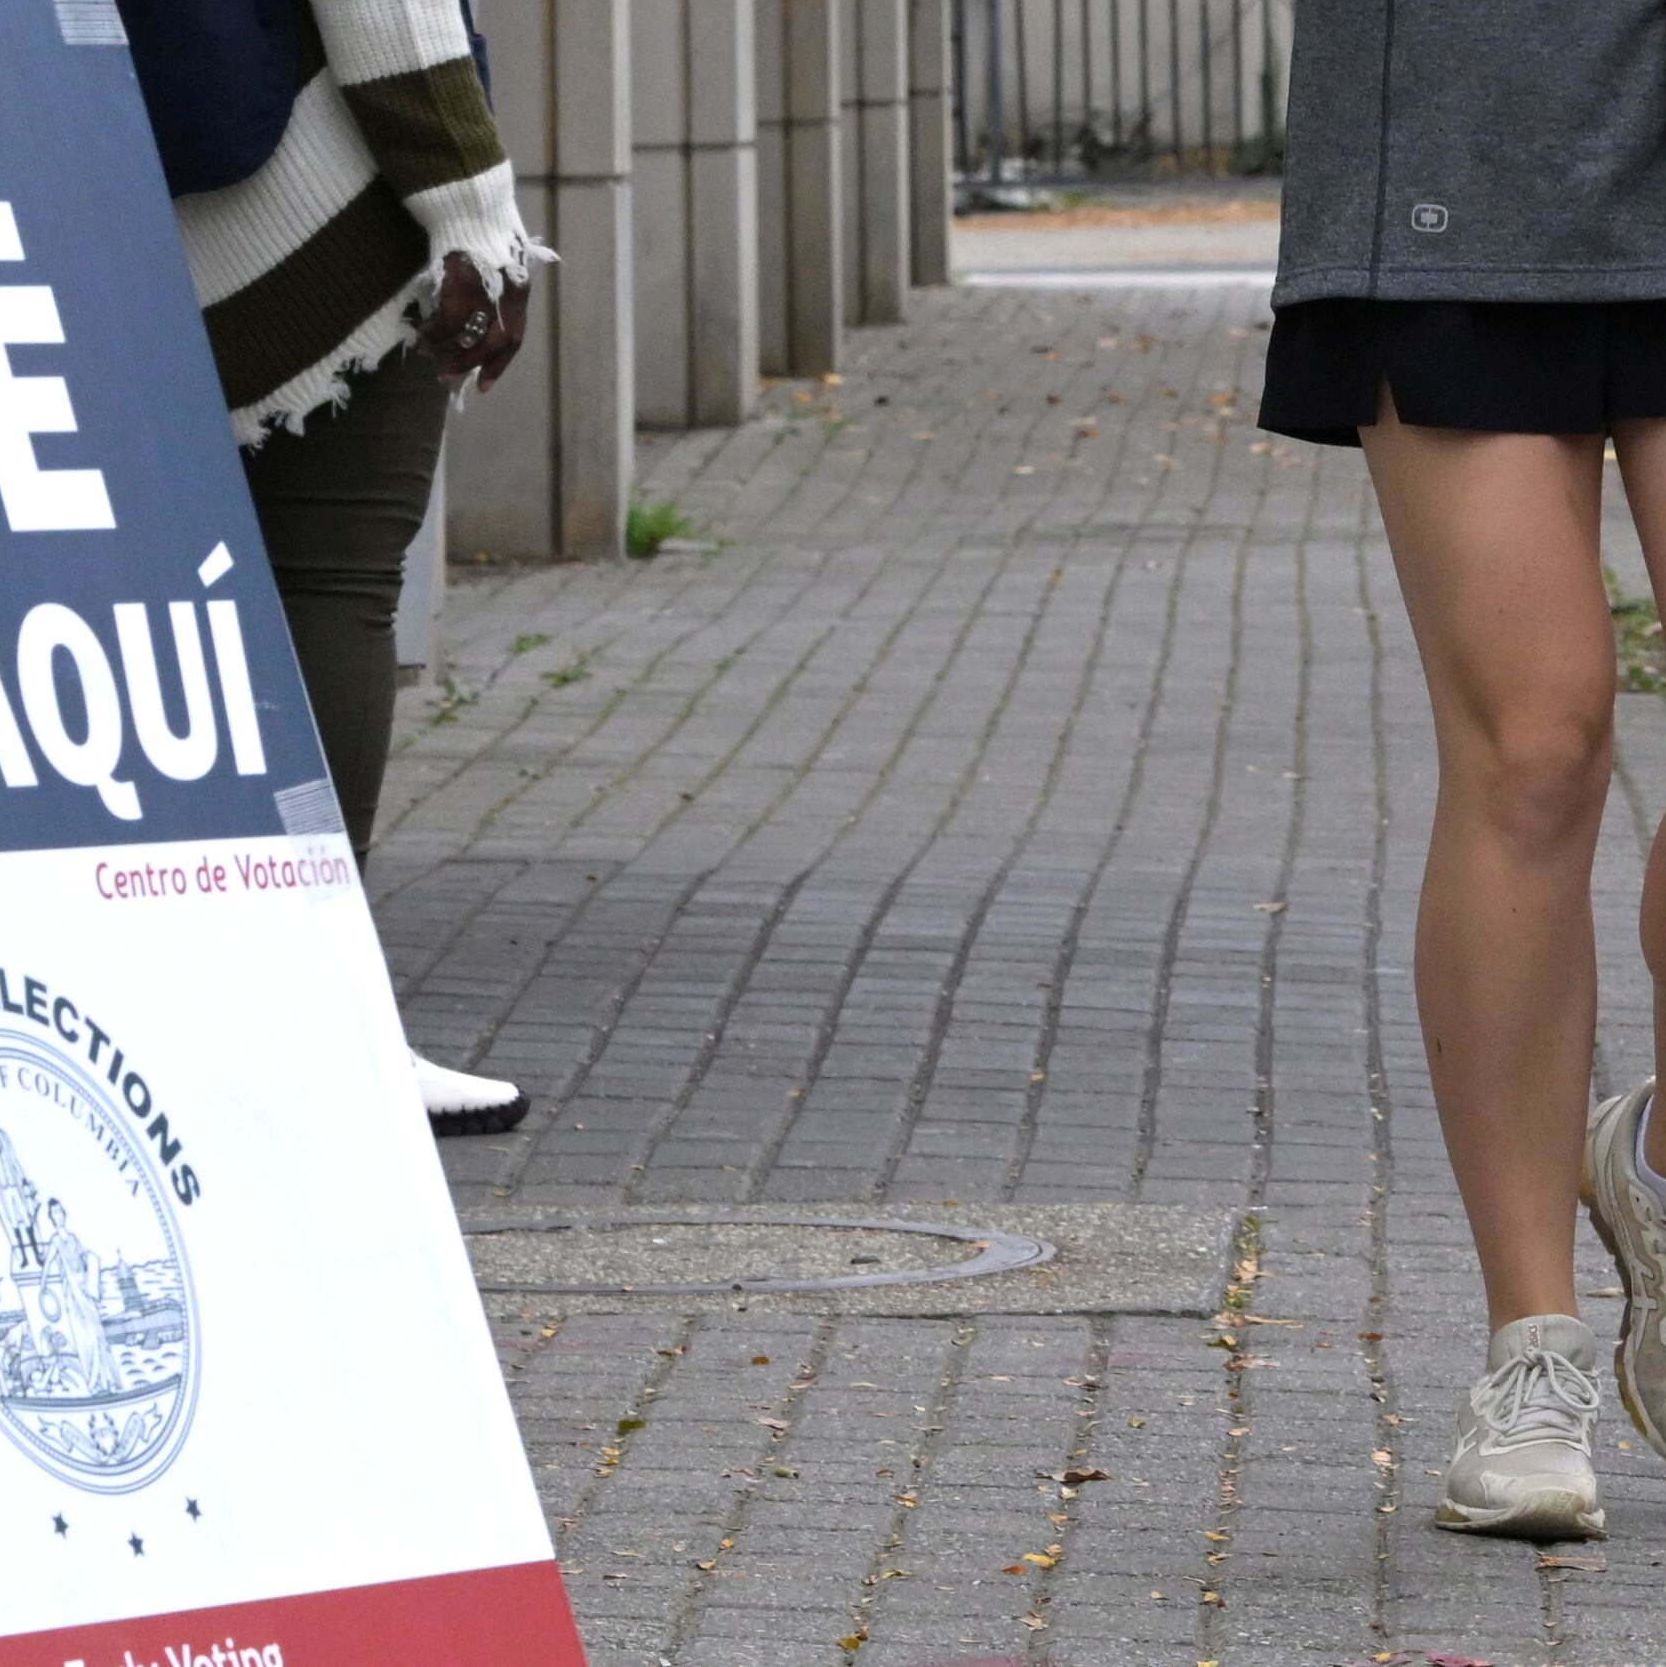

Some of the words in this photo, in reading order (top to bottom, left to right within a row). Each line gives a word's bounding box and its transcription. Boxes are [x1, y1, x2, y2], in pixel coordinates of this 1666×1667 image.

[95, 861, 188, 900] Centro
[195, 854, 228, 894] de
[233, 844, 351, 891] Votación
[16, 1064, 142, 1198] COLUMBIA
